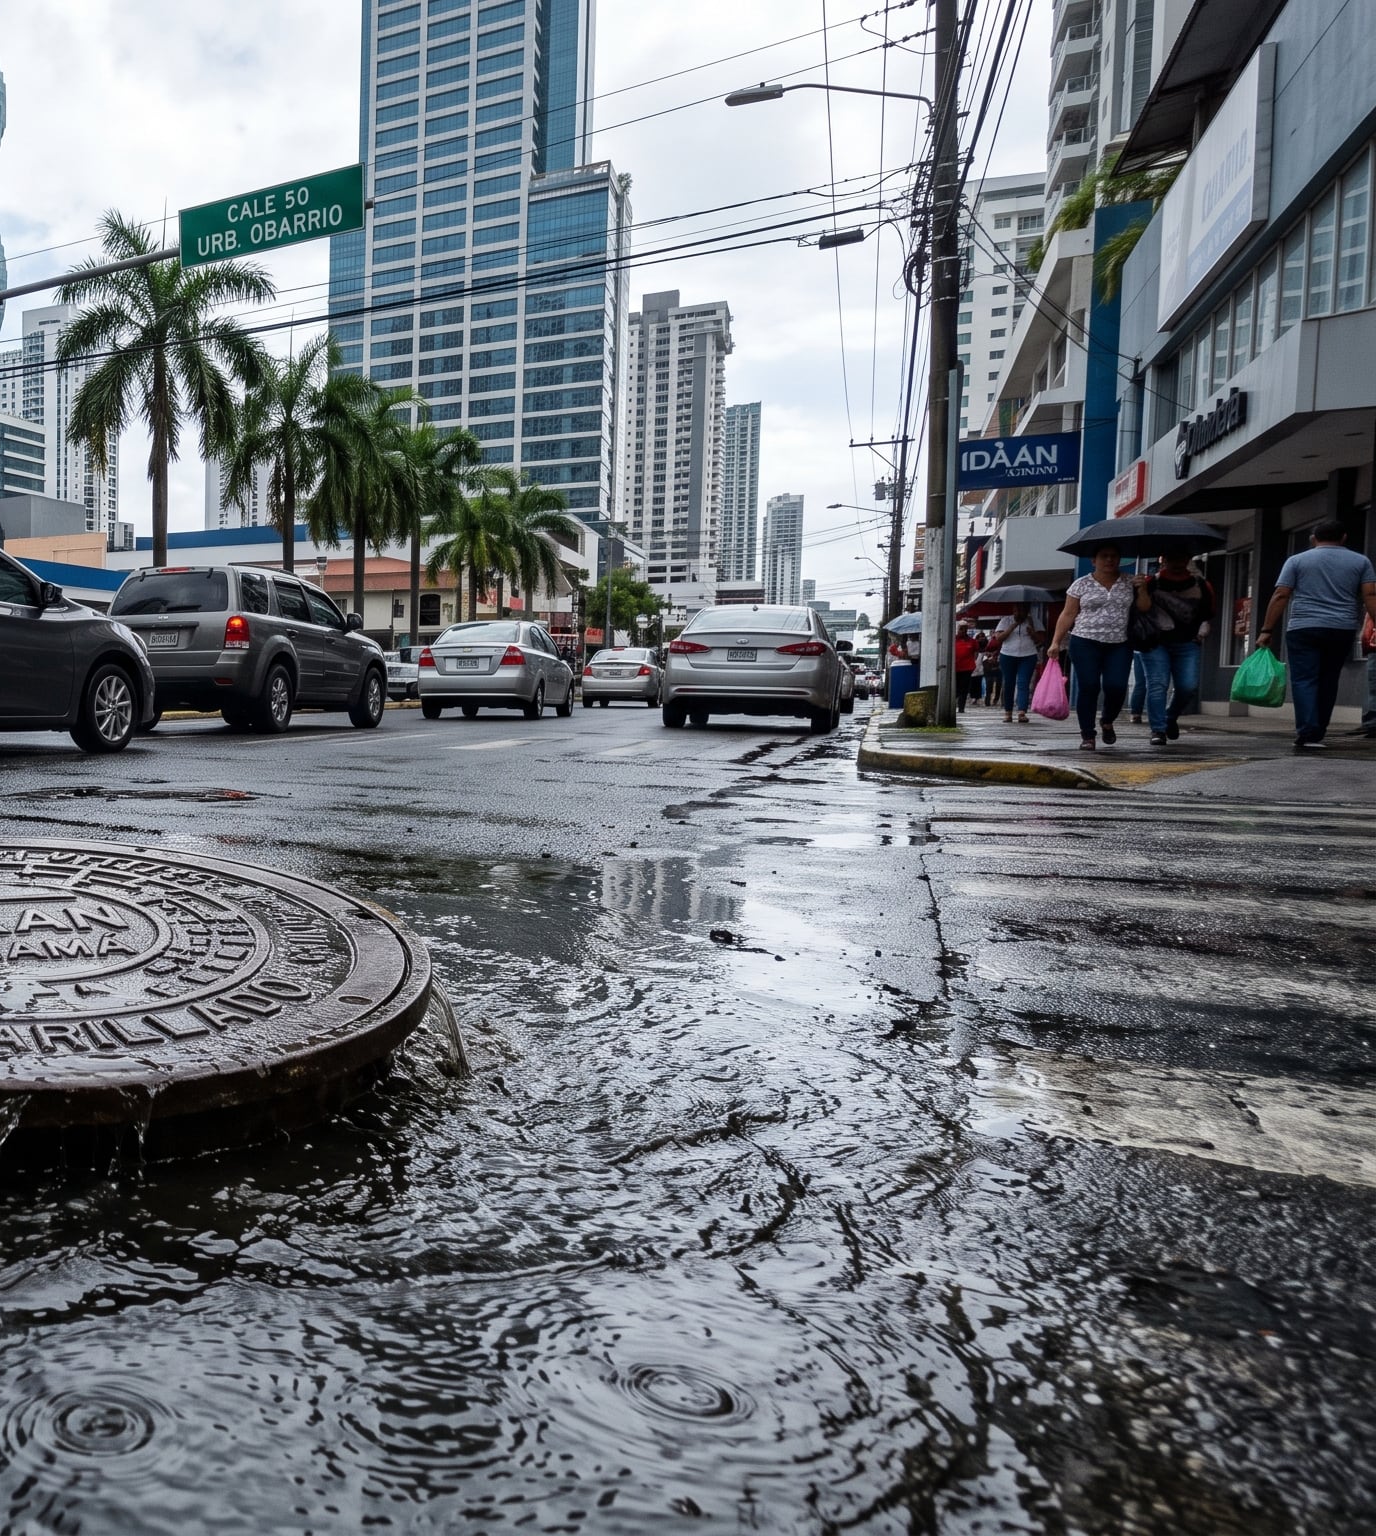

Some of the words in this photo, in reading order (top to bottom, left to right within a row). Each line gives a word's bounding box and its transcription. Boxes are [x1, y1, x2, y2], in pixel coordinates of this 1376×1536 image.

[227, 194, 276, 223] CALE
[285, 186, 310, 210] 50
[197, 229, 241, 257] URB.
[250, 204, 343, 244] OBARRIO
